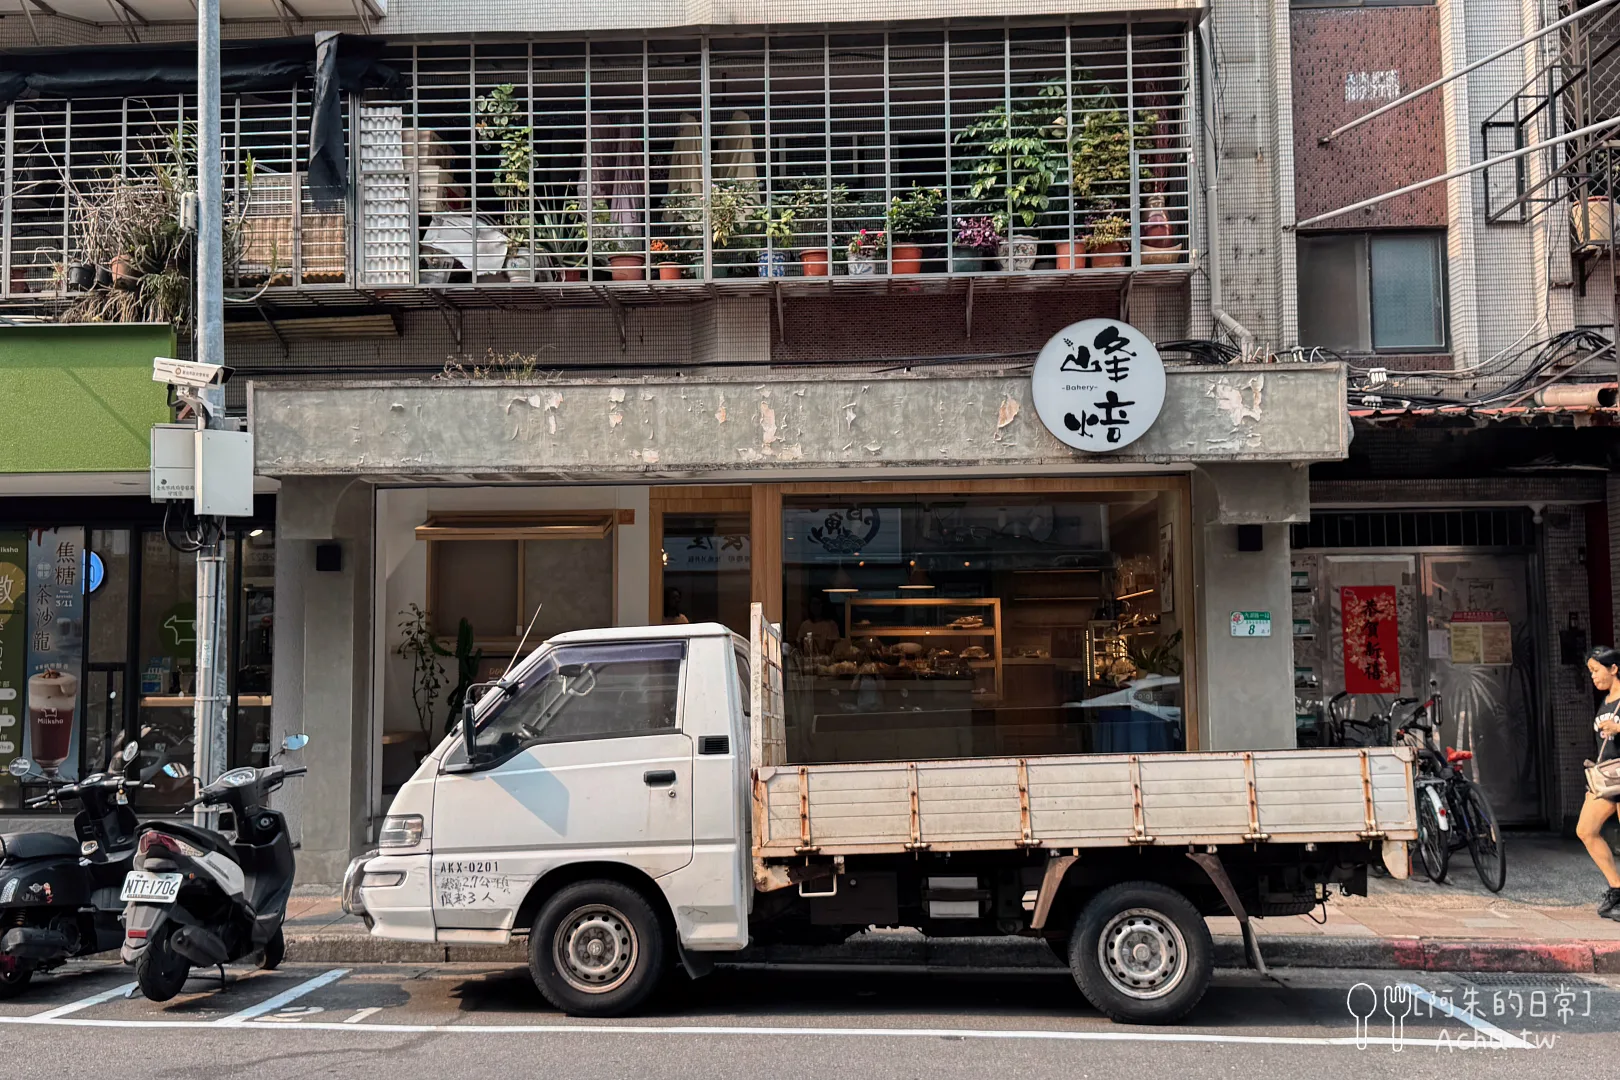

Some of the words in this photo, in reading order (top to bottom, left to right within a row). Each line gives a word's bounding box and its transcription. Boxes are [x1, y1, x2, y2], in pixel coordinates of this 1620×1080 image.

[56, 541, 76, 586] 焦糖
[33, 583, 54, 652] 茶沙龍
[1248, 624, 1256, 635] 8
[1361, 598, 1384, 681] 恭賀新禧
[37, 717, 64, 725] Milksha
[440, 861, 498, 874] AKX-0201
[124, 878, 178, 896] NTT-1706
